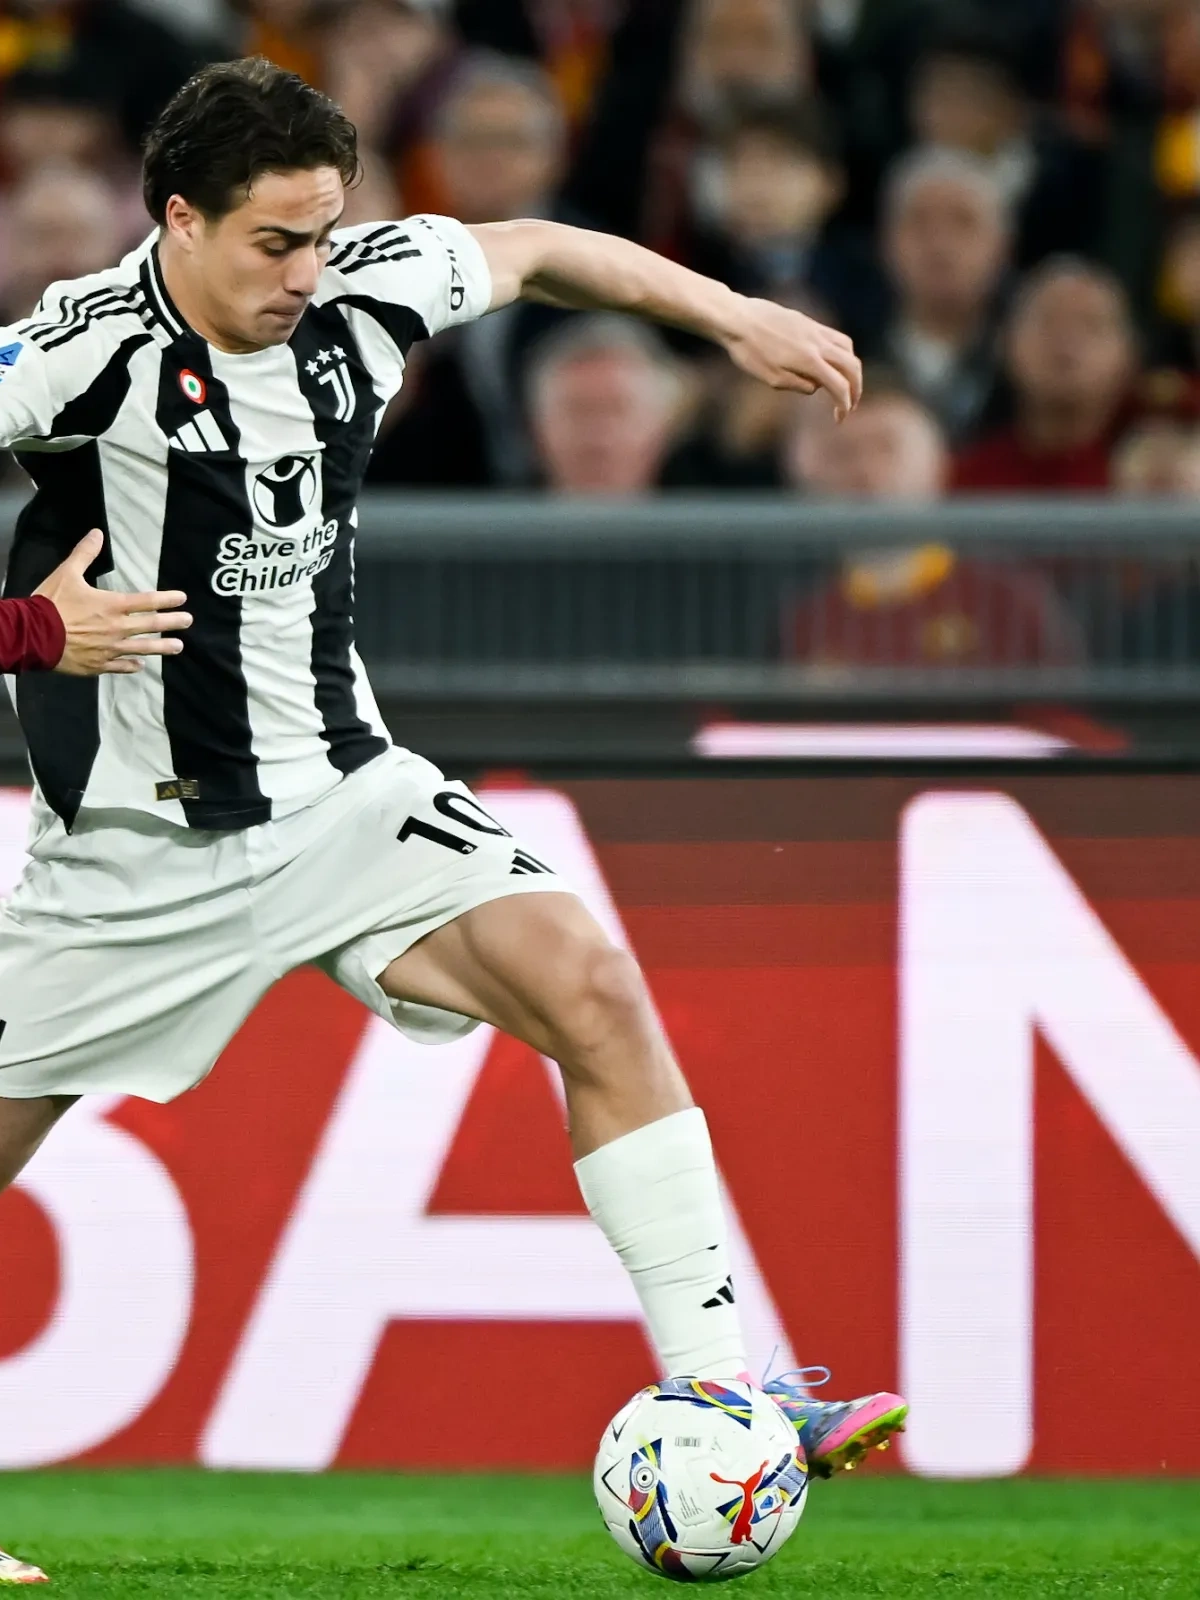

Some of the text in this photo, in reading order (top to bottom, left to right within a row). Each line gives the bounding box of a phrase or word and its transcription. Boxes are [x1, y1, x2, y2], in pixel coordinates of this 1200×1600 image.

[222, 523, 335, 561] Save the
[216, 553, 331, 592] Children
[396, 791, 514, 855] 10
